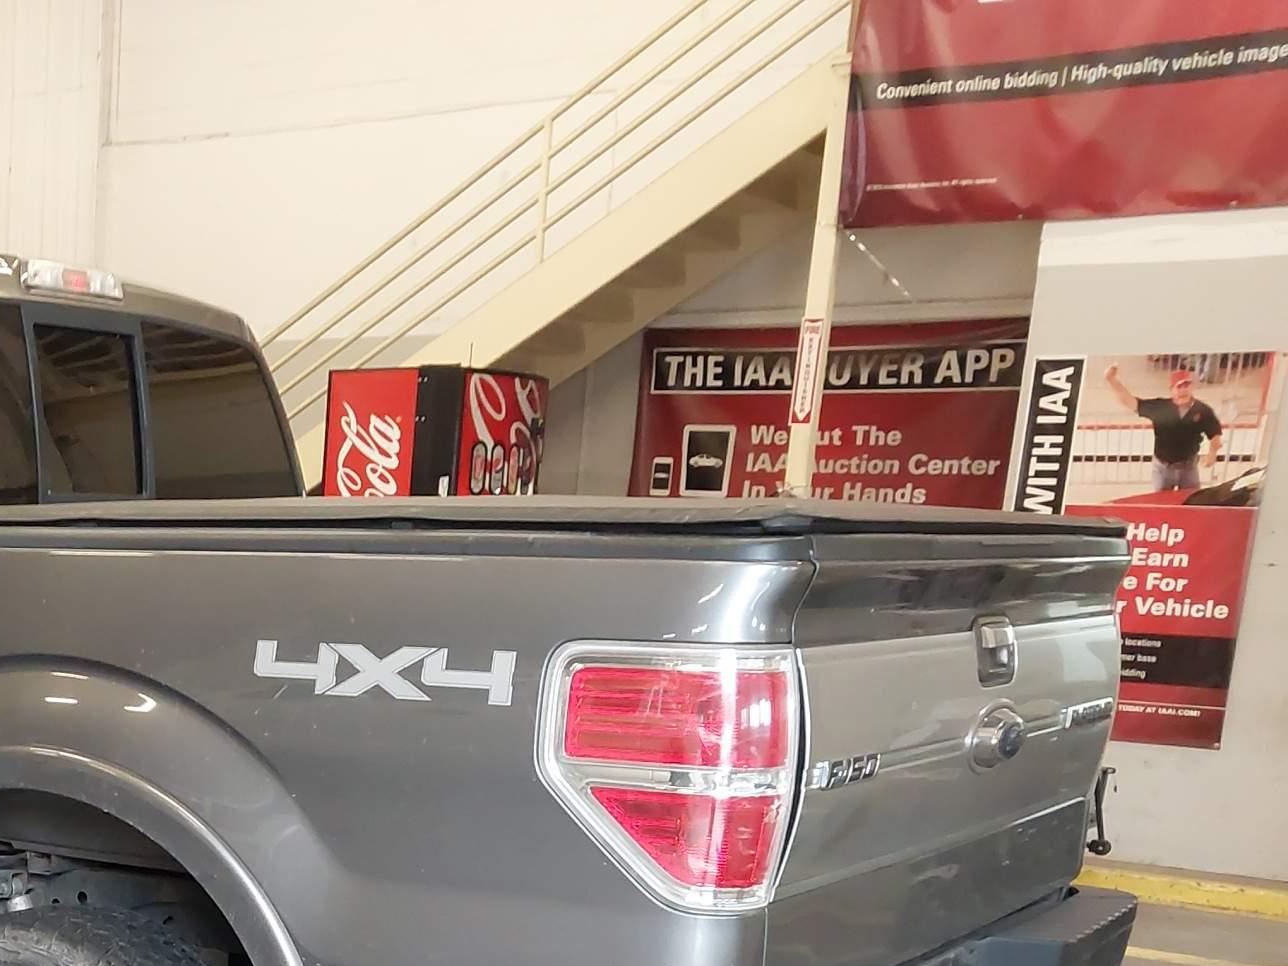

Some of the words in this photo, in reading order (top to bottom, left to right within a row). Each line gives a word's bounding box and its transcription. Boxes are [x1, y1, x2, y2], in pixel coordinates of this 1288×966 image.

[876, 79, 952, 100] Convenient
[955, 74, 1000, 92] online
[1004, 70, 1058, 89] bidding
[1070, 56, 1169, 84] High-quality
[1172, 48, 1234, 72] vehicle
[665, 355, 725, 387] THE
[733, 354, 792, 387] IAA
[828, 352, 926, 387] UYER
[934, 347, 1016, 384] APP
[1036, 366, 1075, 425] IAA
[750, 424, 788, 445] We
[815, 427, 843, 446] ut
[852, 425, 902, 446] The
[907, 453, 1001, 475] Center
[1023, 435, 1064, 515] WITH
[741, 480, 766, 499] In
[842, 481, 927, 504] Hands
[1126, 522, 1185, 547] Help
[1132, 547, 1189, 568] Earn
[1145, 572, 1189, 592] For
[1135, 596, 1230, 619] Vehicle
